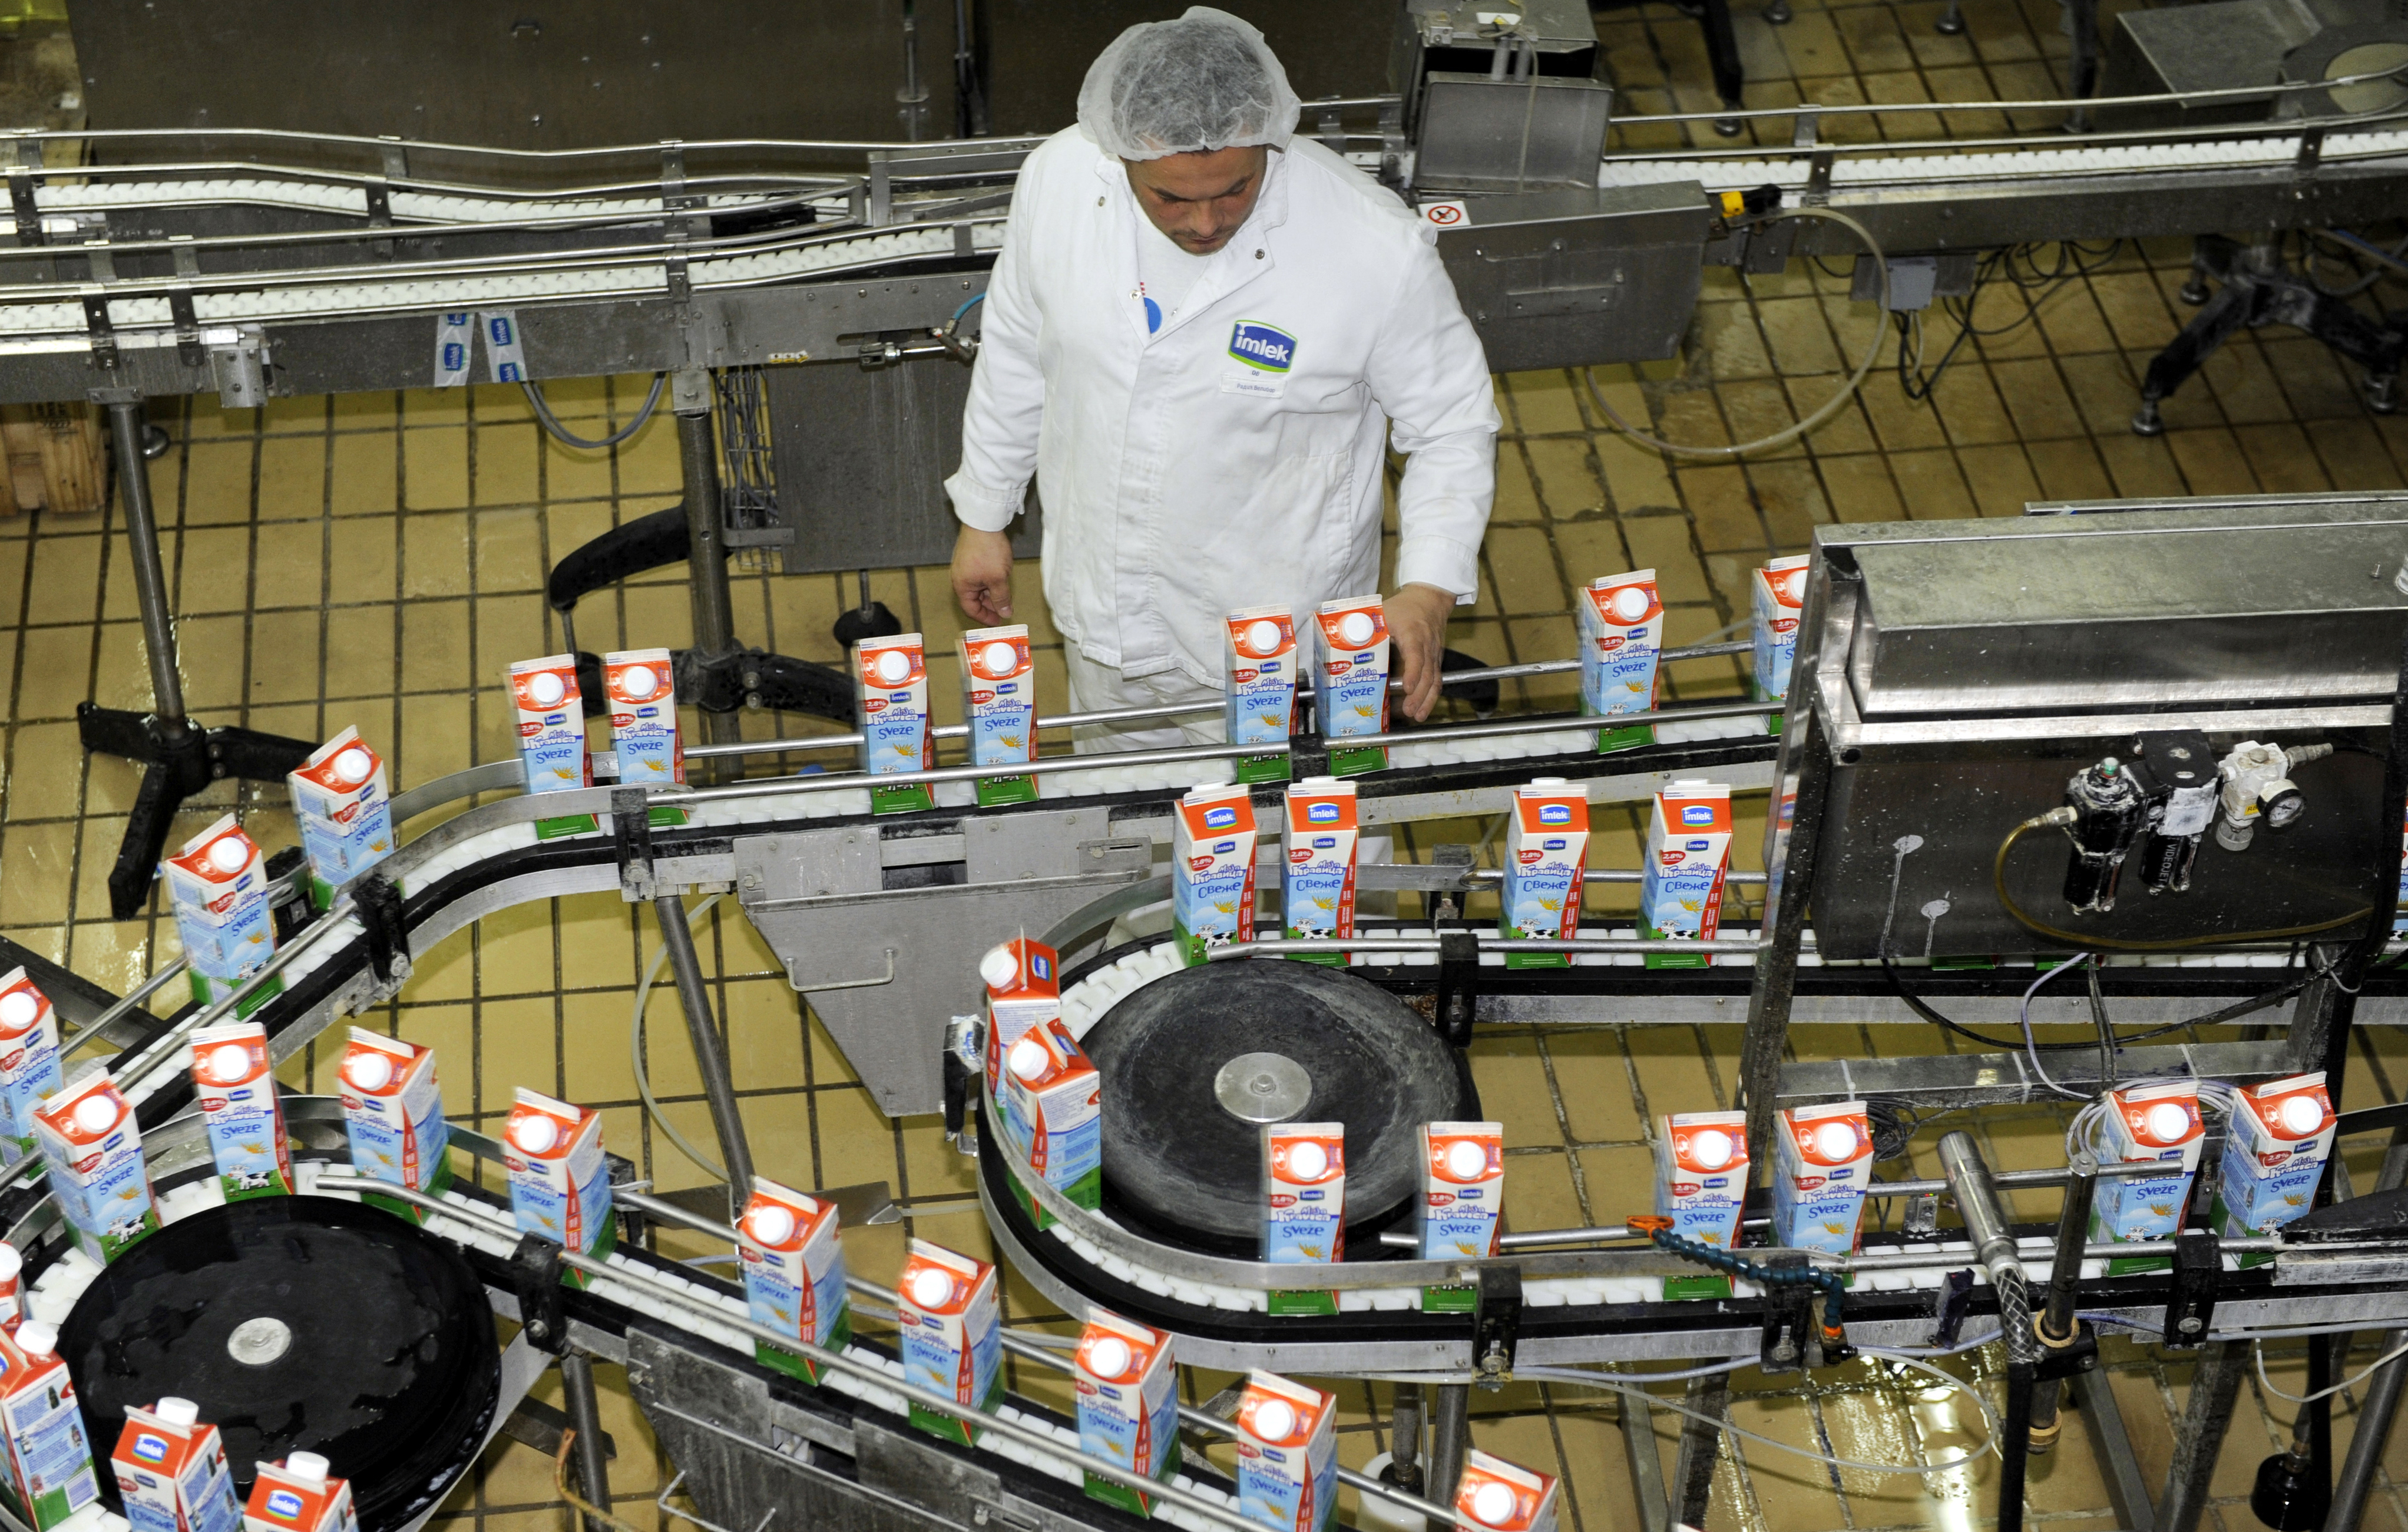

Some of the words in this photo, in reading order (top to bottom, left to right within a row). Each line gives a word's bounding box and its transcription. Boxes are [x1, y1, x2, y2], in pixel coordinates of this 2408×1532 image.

[1235, 325, 1289, 362] imlek
[1629, 630, 1647, 638] imlek
[1355, 653, 1373, 663] imlek
[1608, 649, 1652, 663] Kravica
[1261, 663, 1280, 672] imlek
[1336, 674, 1380, 688] Kravica
[998, 684, 1017, 693] imlek
[1242, 683, 1287, 696] Kravica
[891, 694, 910, 702] imlek
[980, 705, 1025, 717] Kravica
[546, 715, 565, 724] imlek
[873, 713, 919, 725] Kravica
[620, 729, 667, 741] Kravica
[528, 736, 576, 750] Kravica
[1310, 808, 1337, 818] imlek
[1542, 810, 1567, 820] imlek
[1685, 811, 1710, 821] imlek
[1208, 814, 1233, 825] imlek
[1215, 842, 1234, 852] imlek
[1314, 838, 1335, 847] imlek
[2158, 844, 2177, 882] VIDEOJET
[2296, 1141, 2316, 1152] imlek
[2161, 1150, 2182, 1159] imlek
[2268, 1151, 2288, 1161] 2,8%
[2293, 1156, 2316, 1166] Moja
[1830, 1170, 1853, 1179] imlek
[2269, 1161, 2318, 1180] Kravica
[1704, 1178, 1727, 1187] imlek
[1301, 1191, 1324, 1199] imlek
[1459, 1190, 1482, 1198] imlek
[1805, 1190, 1857, 1204] Kravica
[1679, 1198, 1733, 1210] Kravica
[1277, 1210, 1331, 1222] Kravica
[1435, 1209, 1489, 1220] Kravica
[137, 1439, 164, 1457] imlek
[270, 1495, 299, 1512] imlek
